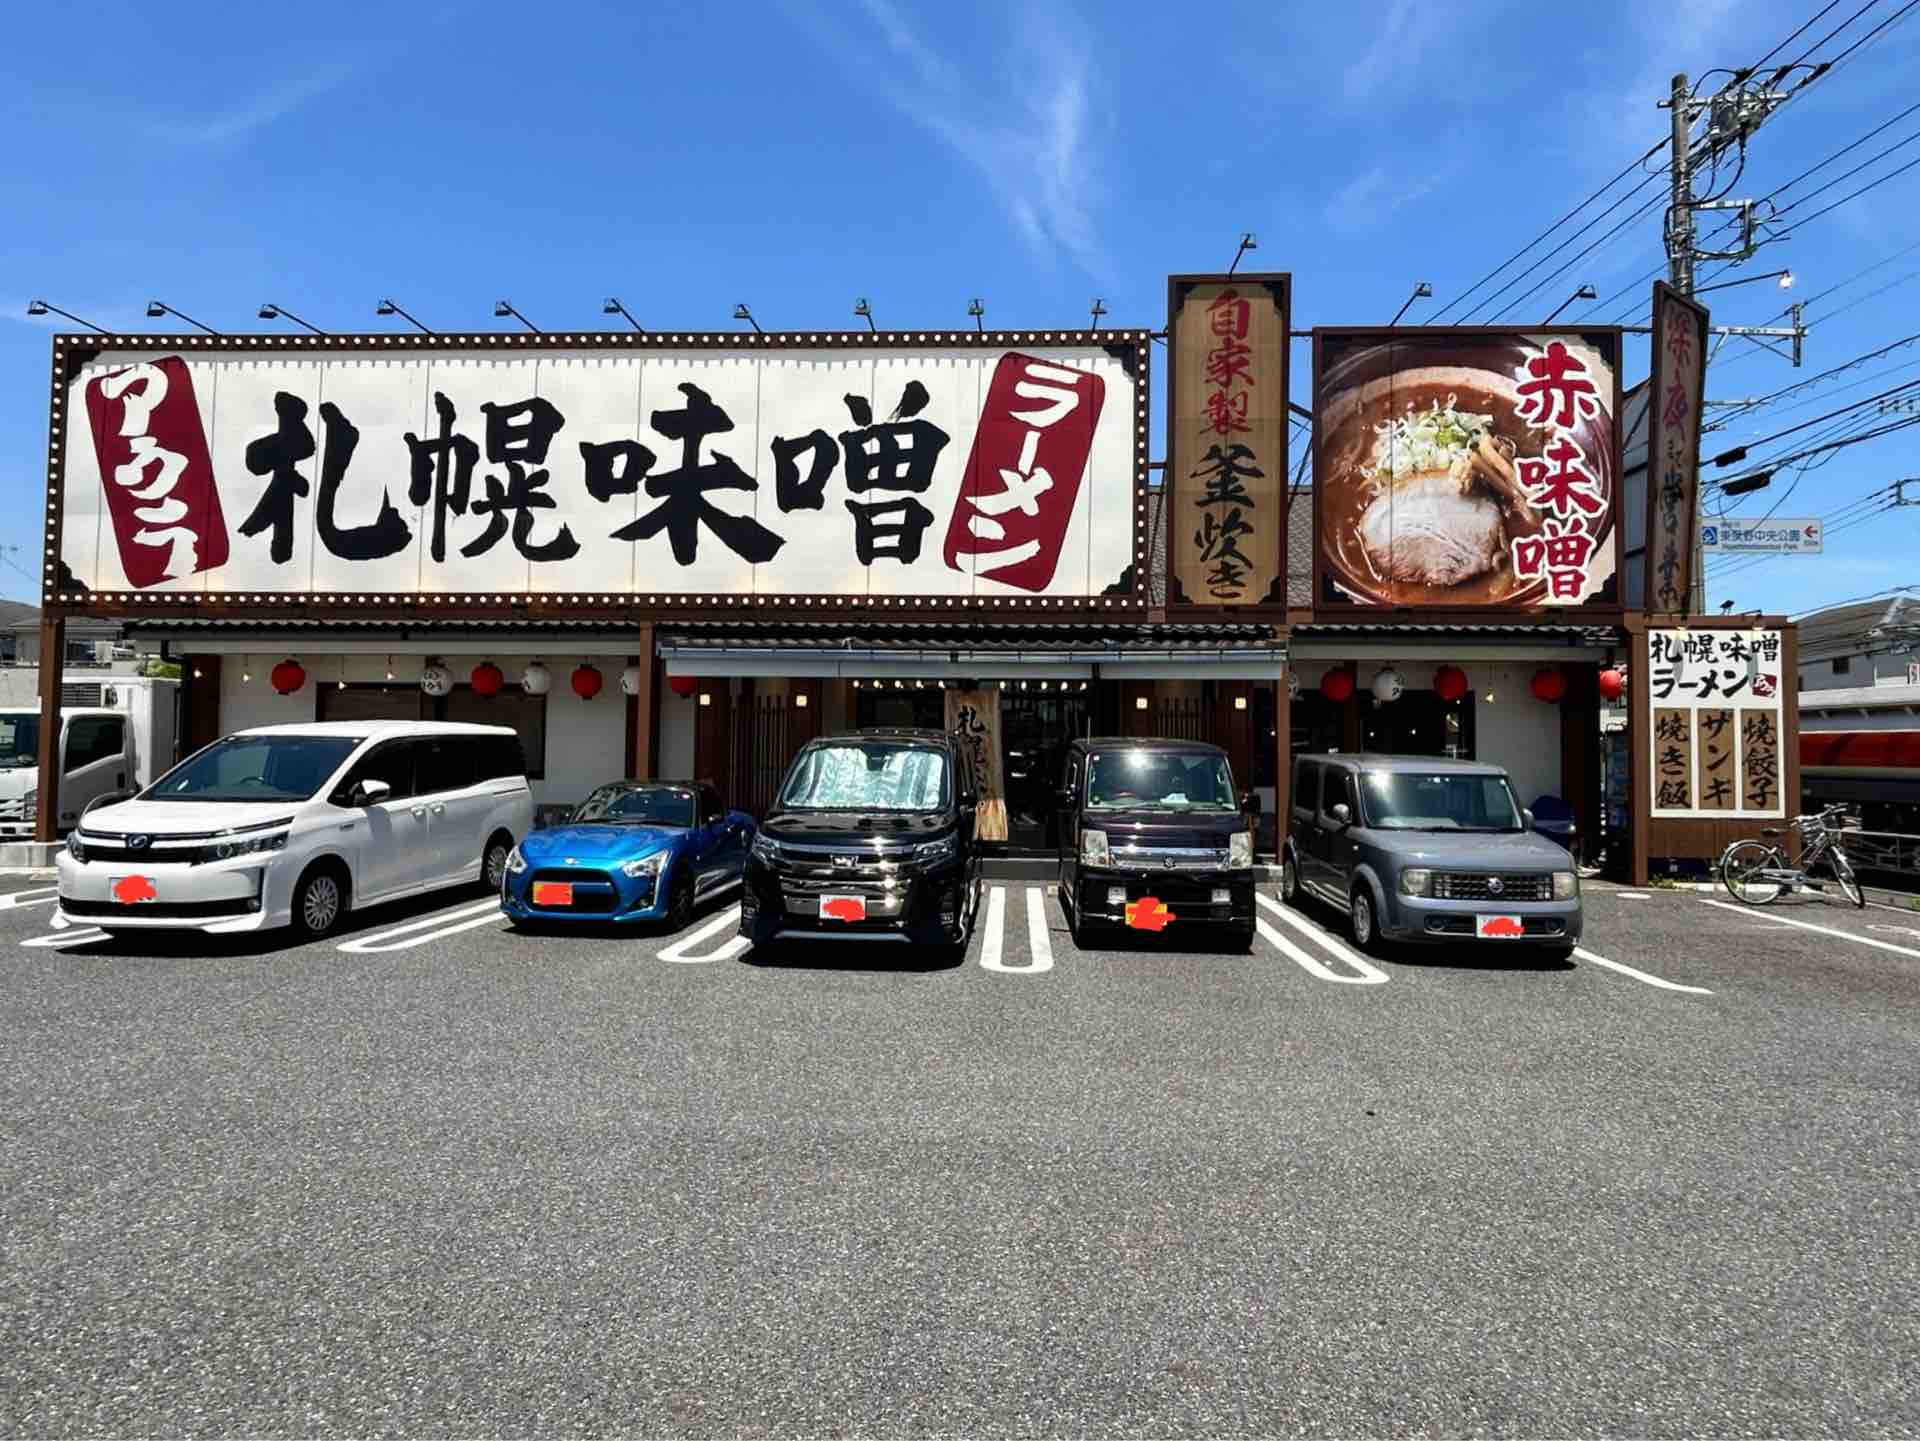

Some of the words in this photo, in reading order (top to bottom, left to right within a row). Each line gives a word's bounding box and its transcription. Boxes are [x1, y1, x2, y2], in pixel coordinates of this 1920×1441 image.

[237, 380, 951, 566] 札幌味噌
[964, 362, 1083, 577] ラーメン
[1190, 287, 1265, 599] 自家製釜炊き
[1513, 340, 1607, 599] 赤味噌
[1650, 633, 1779, 664] 札幌味噌
[1653, 669, 1749, 699] ラーメン
[1656, 712, 1692, 808] 焼き飯
[1743, 712, 1778, 808] 焼餃子
